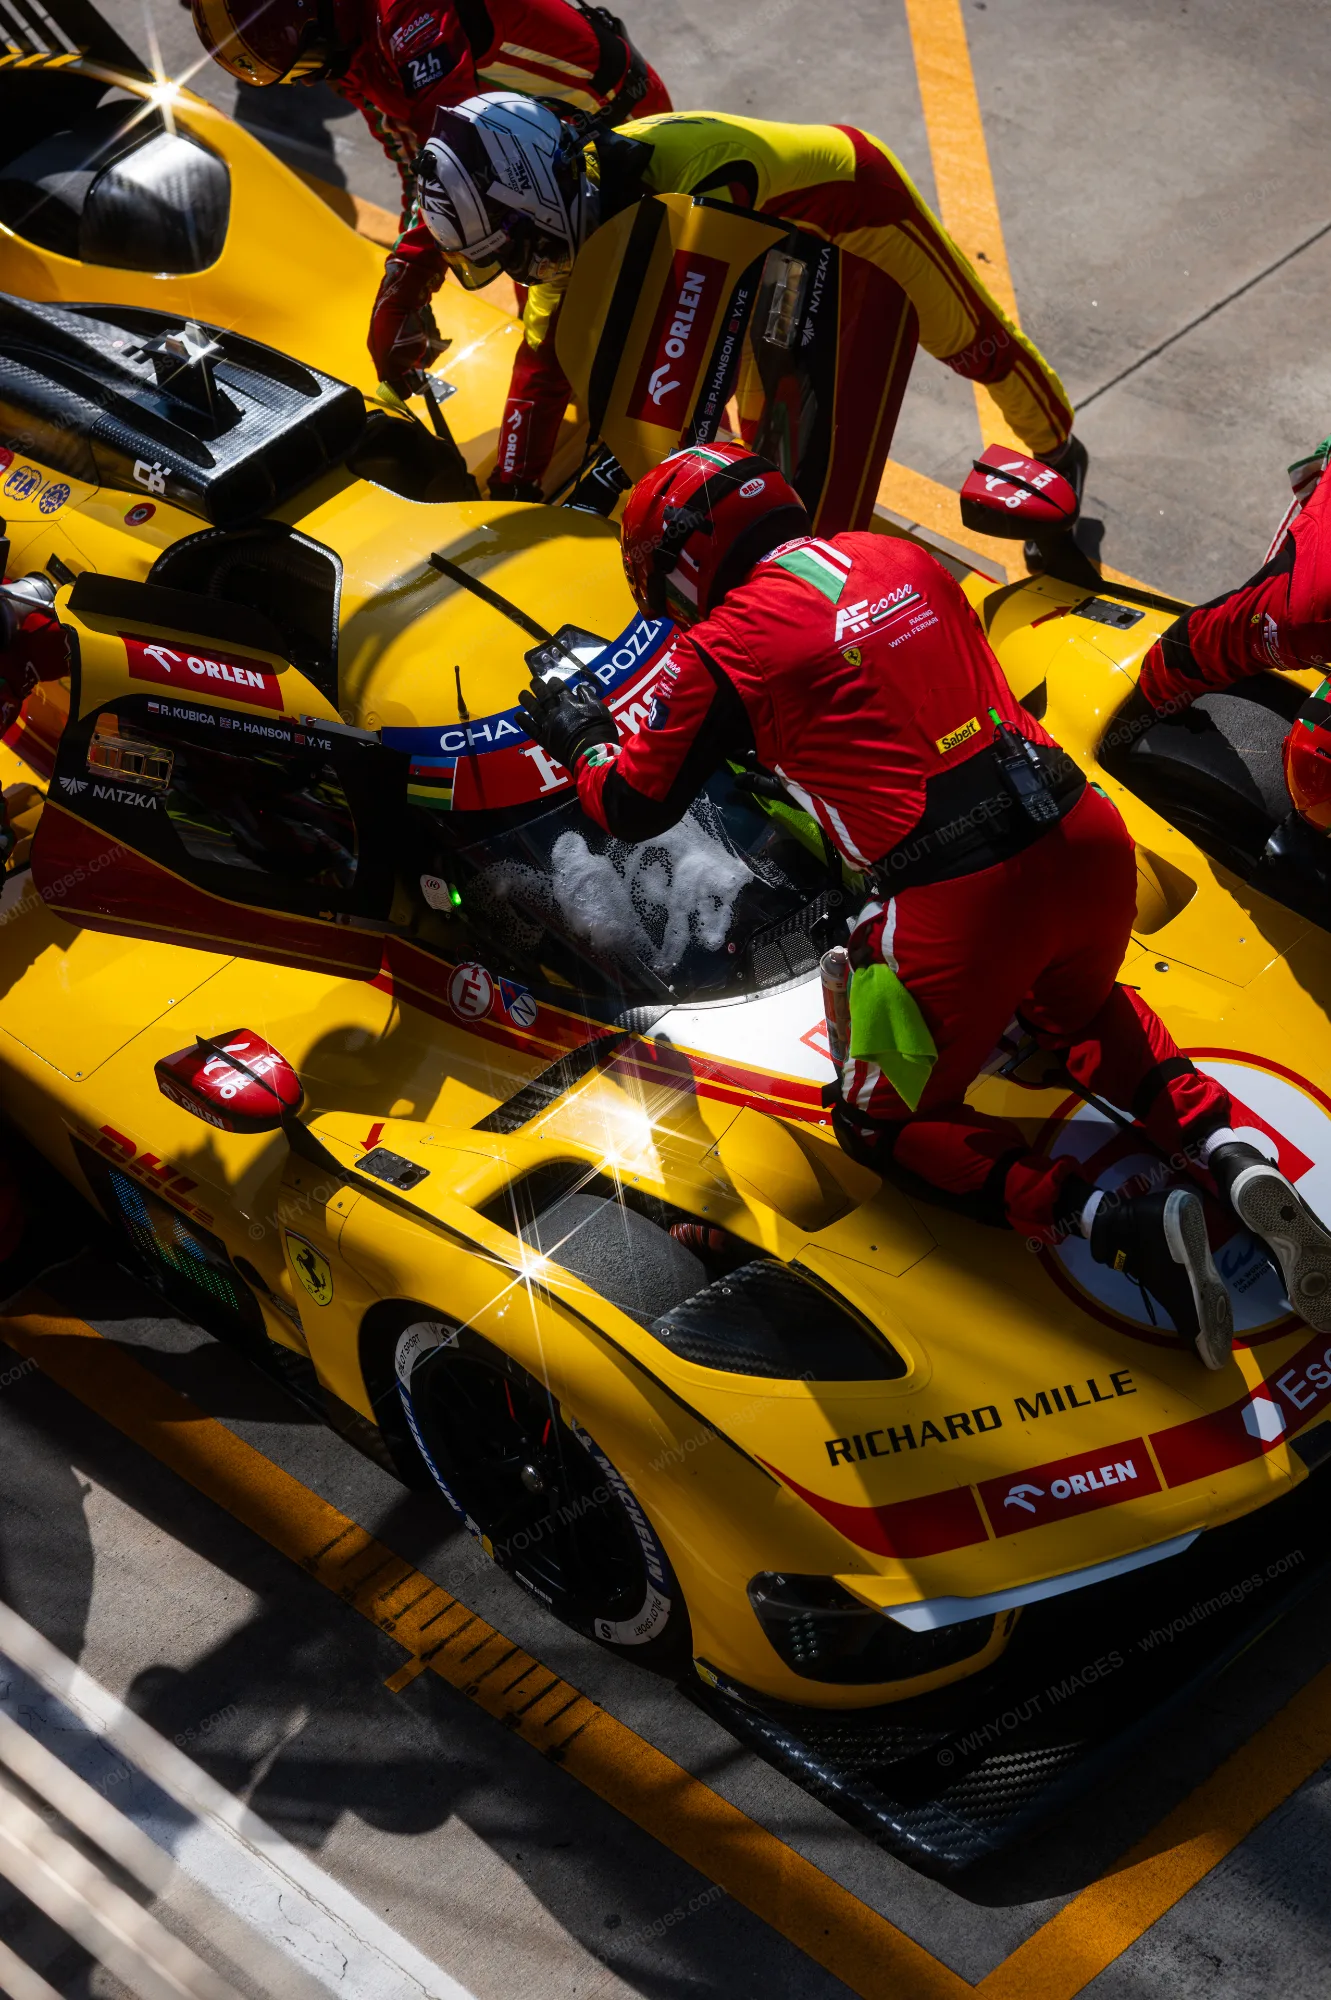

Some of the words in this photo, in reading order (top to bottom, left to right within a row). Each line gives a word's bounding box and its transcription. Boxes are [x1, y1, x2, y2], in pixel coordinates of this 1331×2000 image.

[665, 271, 706, 359] ORLEN
[741, 480, 763, 496] BELL
[1005, 469, 1059, 509] OREN
[908, 608, 934, 626] RACING
[888, 631, 912, 648] WITH
[186, 656, 266, 690] ORLEN
[173, 706, 216, 726] KUBICA
[243, 722, 291, 742] HANSON
[317, 738, 332, 751] YE
[941, 720, 977, 750] Sabelt
[219, 1053, 284, 1099] OREN
[181, 1097, 225, 1130] ORLEN
[824, 1405, 1003, 1467] RICHARD
[1013, 1369, 1138, 1422] MILLE
[1050, 1459, 1138, 1500] ORLEN
[594, 1454, 665, 1584] MICHELIN
